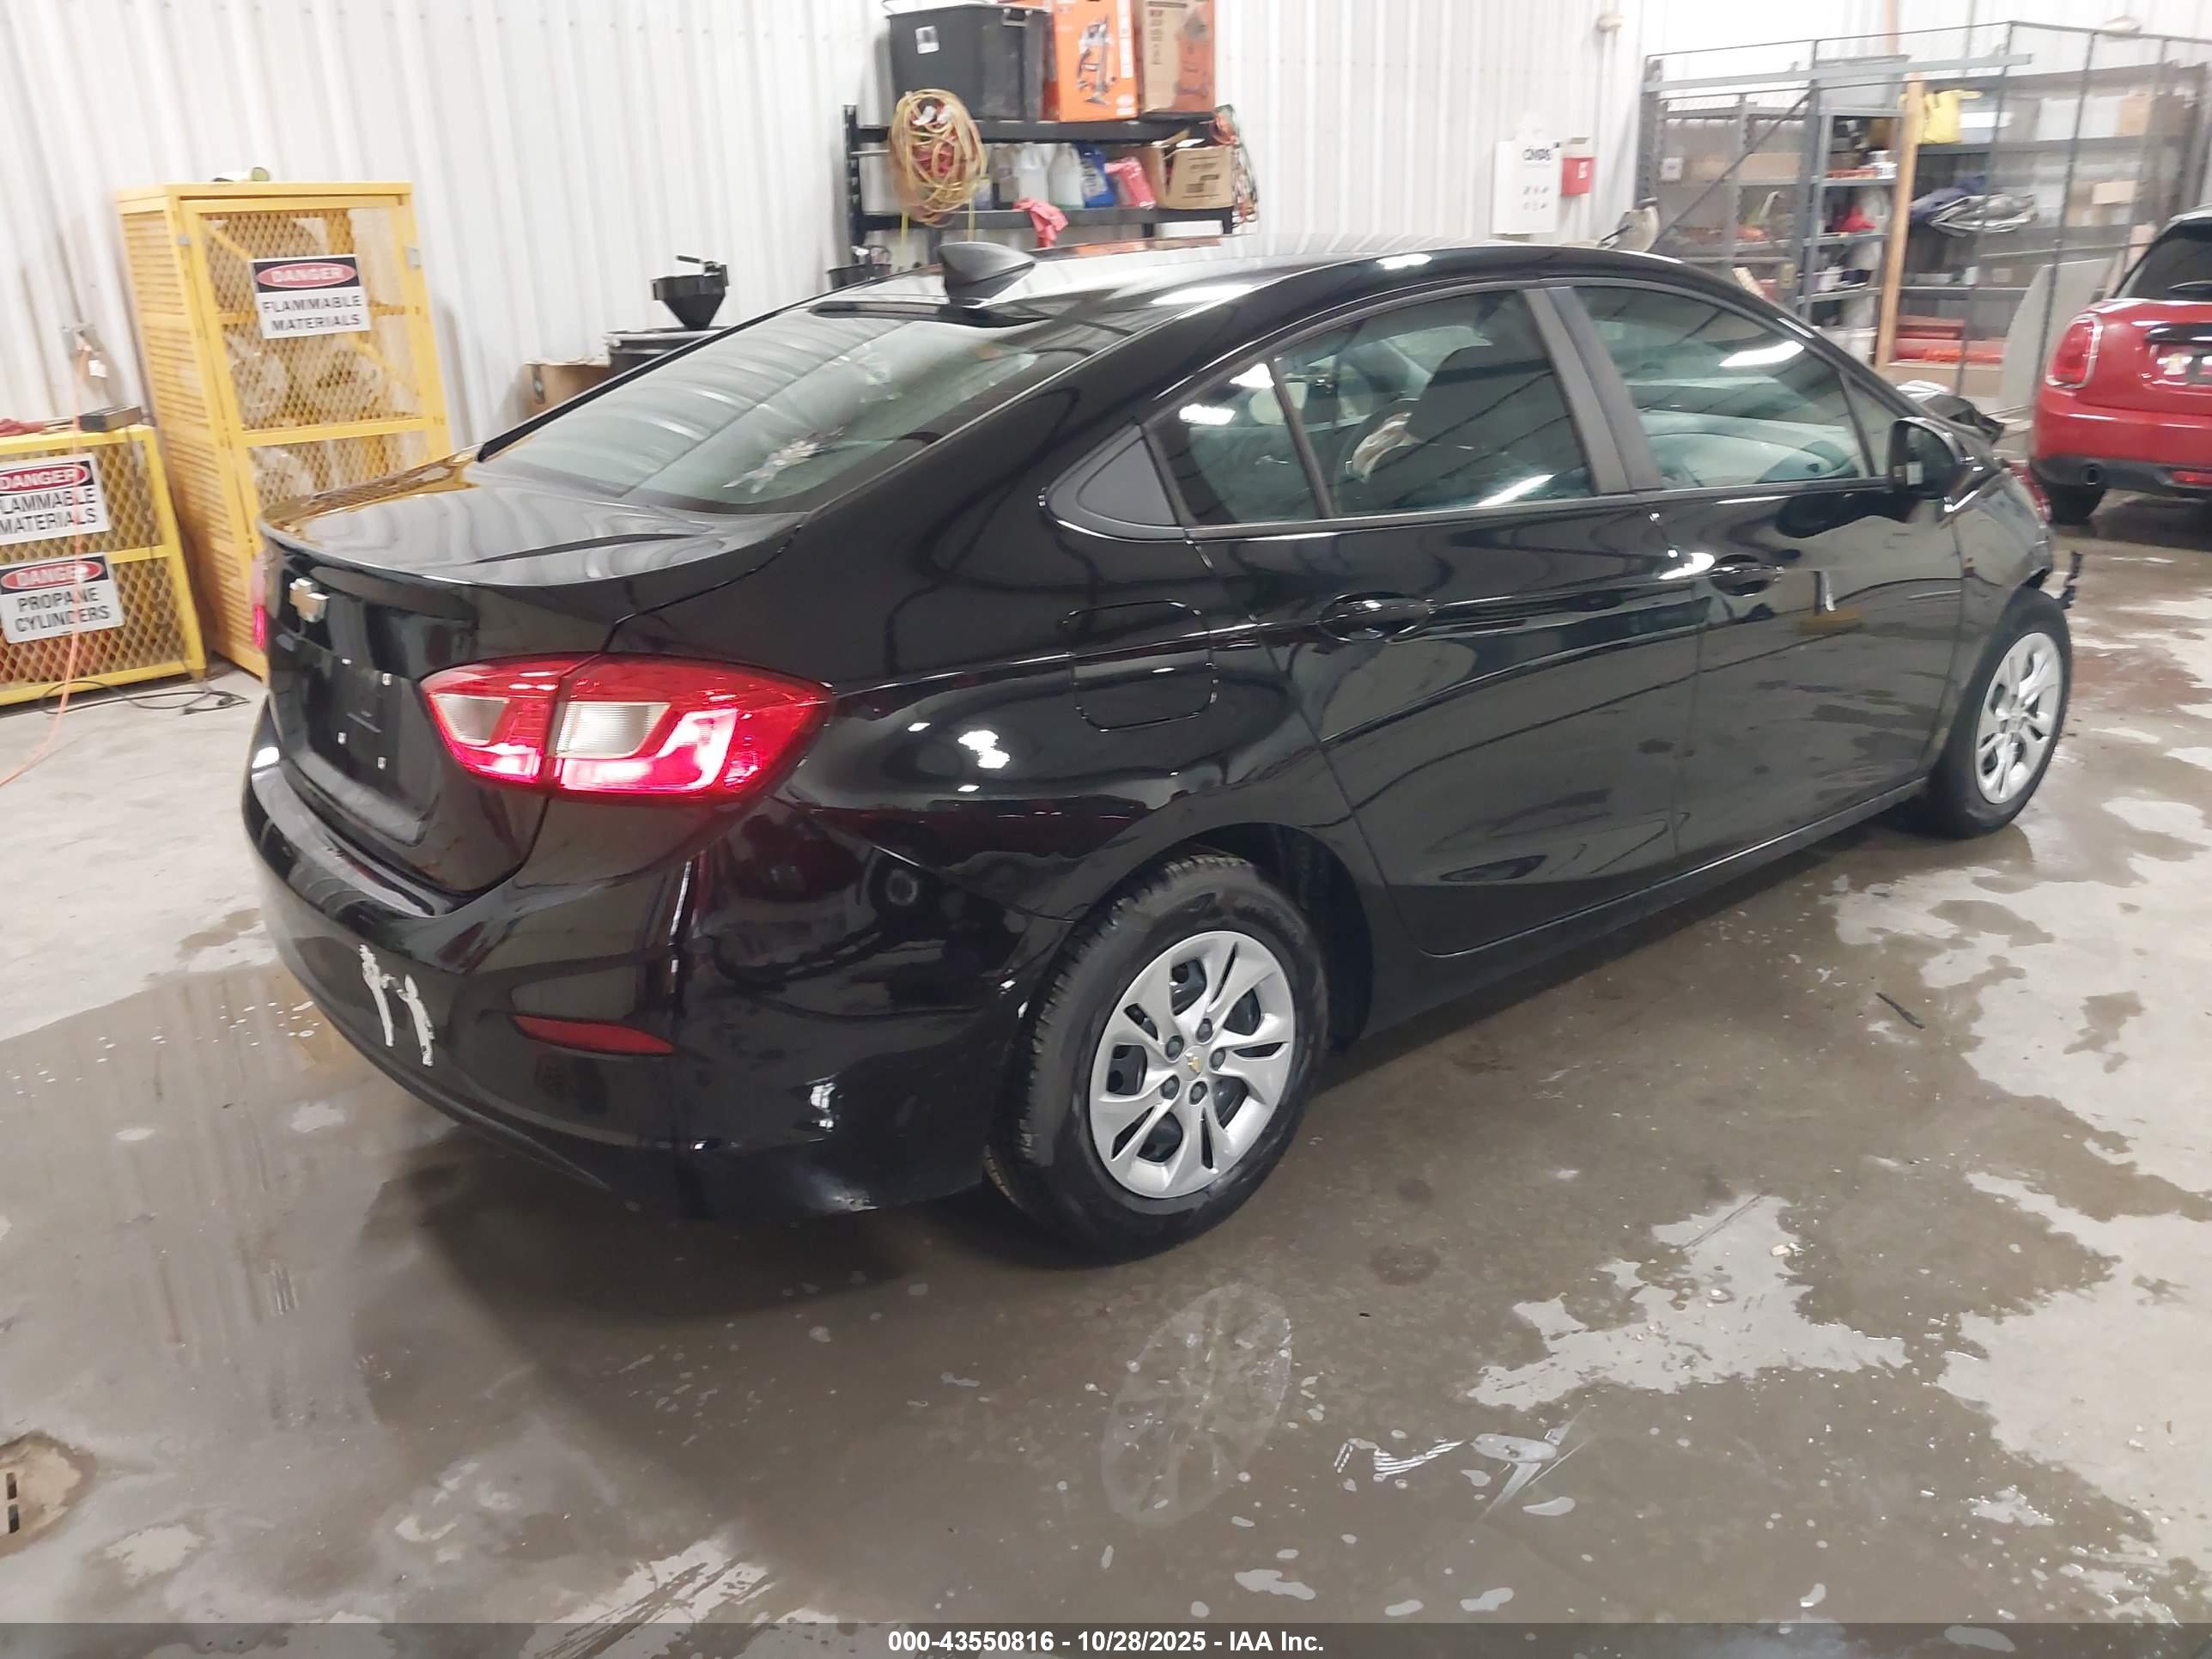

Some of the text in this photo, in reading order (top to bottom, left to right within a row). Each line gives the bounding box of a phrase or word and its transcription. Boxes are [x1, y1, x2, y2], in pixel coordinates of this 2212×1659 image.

[270, 267, 344, 283] DANGER
[261, 295, 362, 313] FLAMMABLE
[270, 313, 361, 331] MATERIALS
[0, 468, 80, 490] DANGER
[0, 487, 97, 515] LAMMABLE
[0, 507, 98, 536] MATERIALS
[16, 563, 86, 586] DANGE
[17, 587, 100, 613] PROPANE
[15, 605, 111, 632] CYLINDERS
